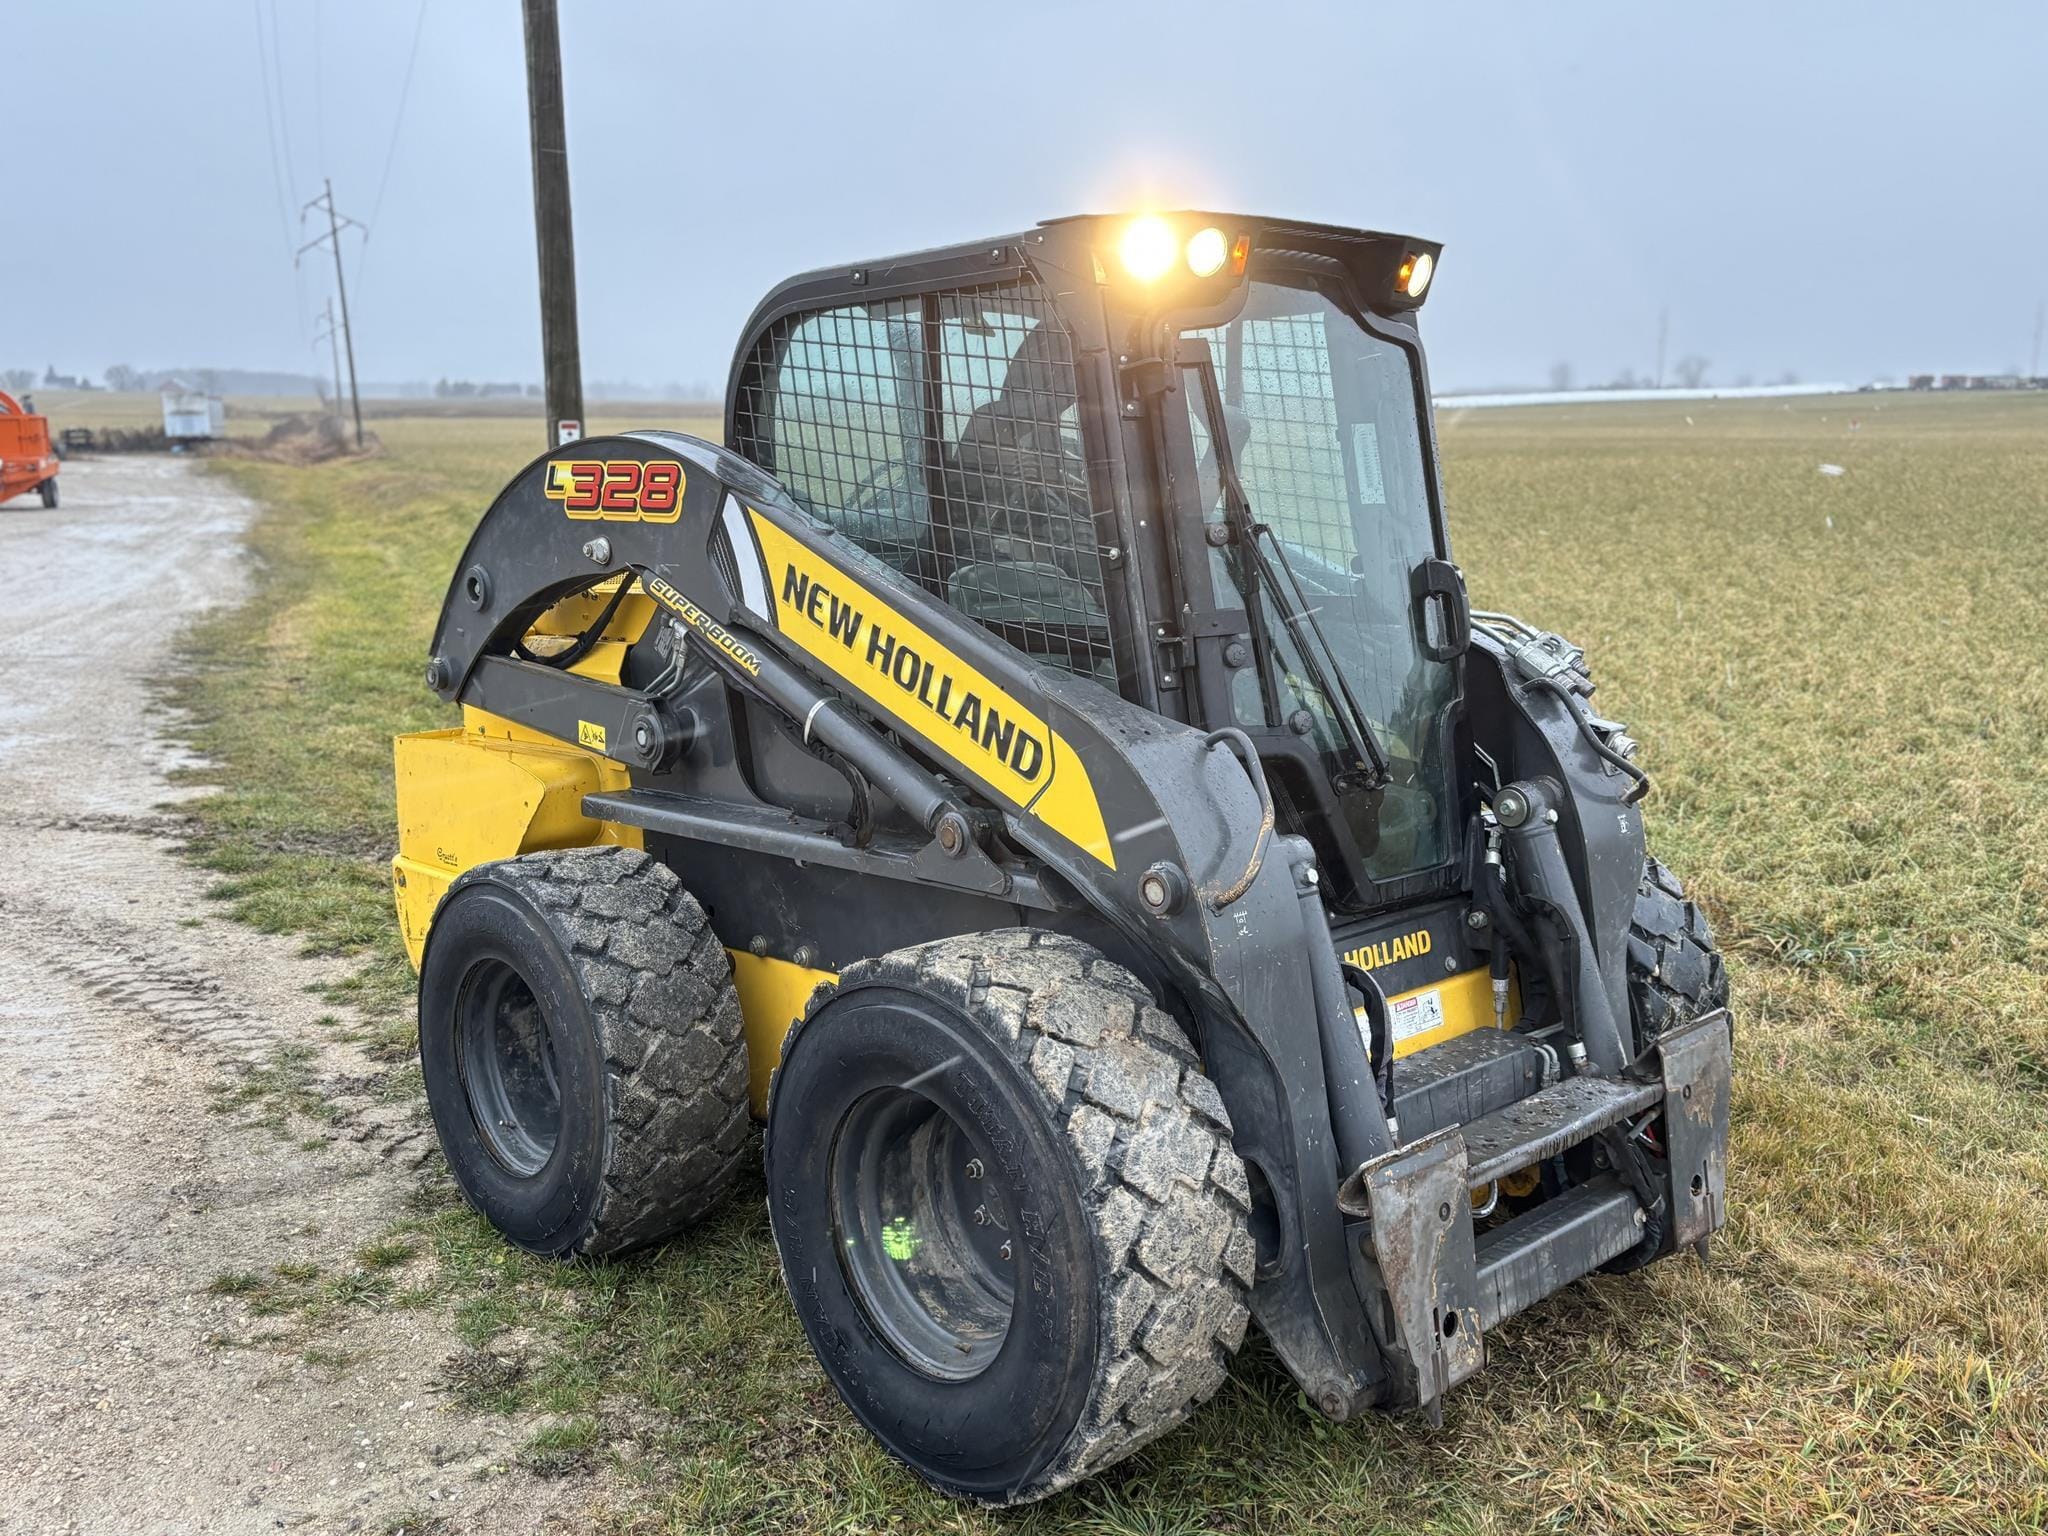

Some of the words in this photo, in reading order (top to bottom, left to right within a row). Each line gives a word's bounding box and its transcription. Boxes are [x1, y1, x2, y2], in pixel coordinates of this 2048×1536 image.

[545, 461, 686, 523] L328
[782, 563, 863, 650] NEW
[865, 623, 1044, 782] HOLLAND
[1343, 930, 1432, 971] HOLLAND
